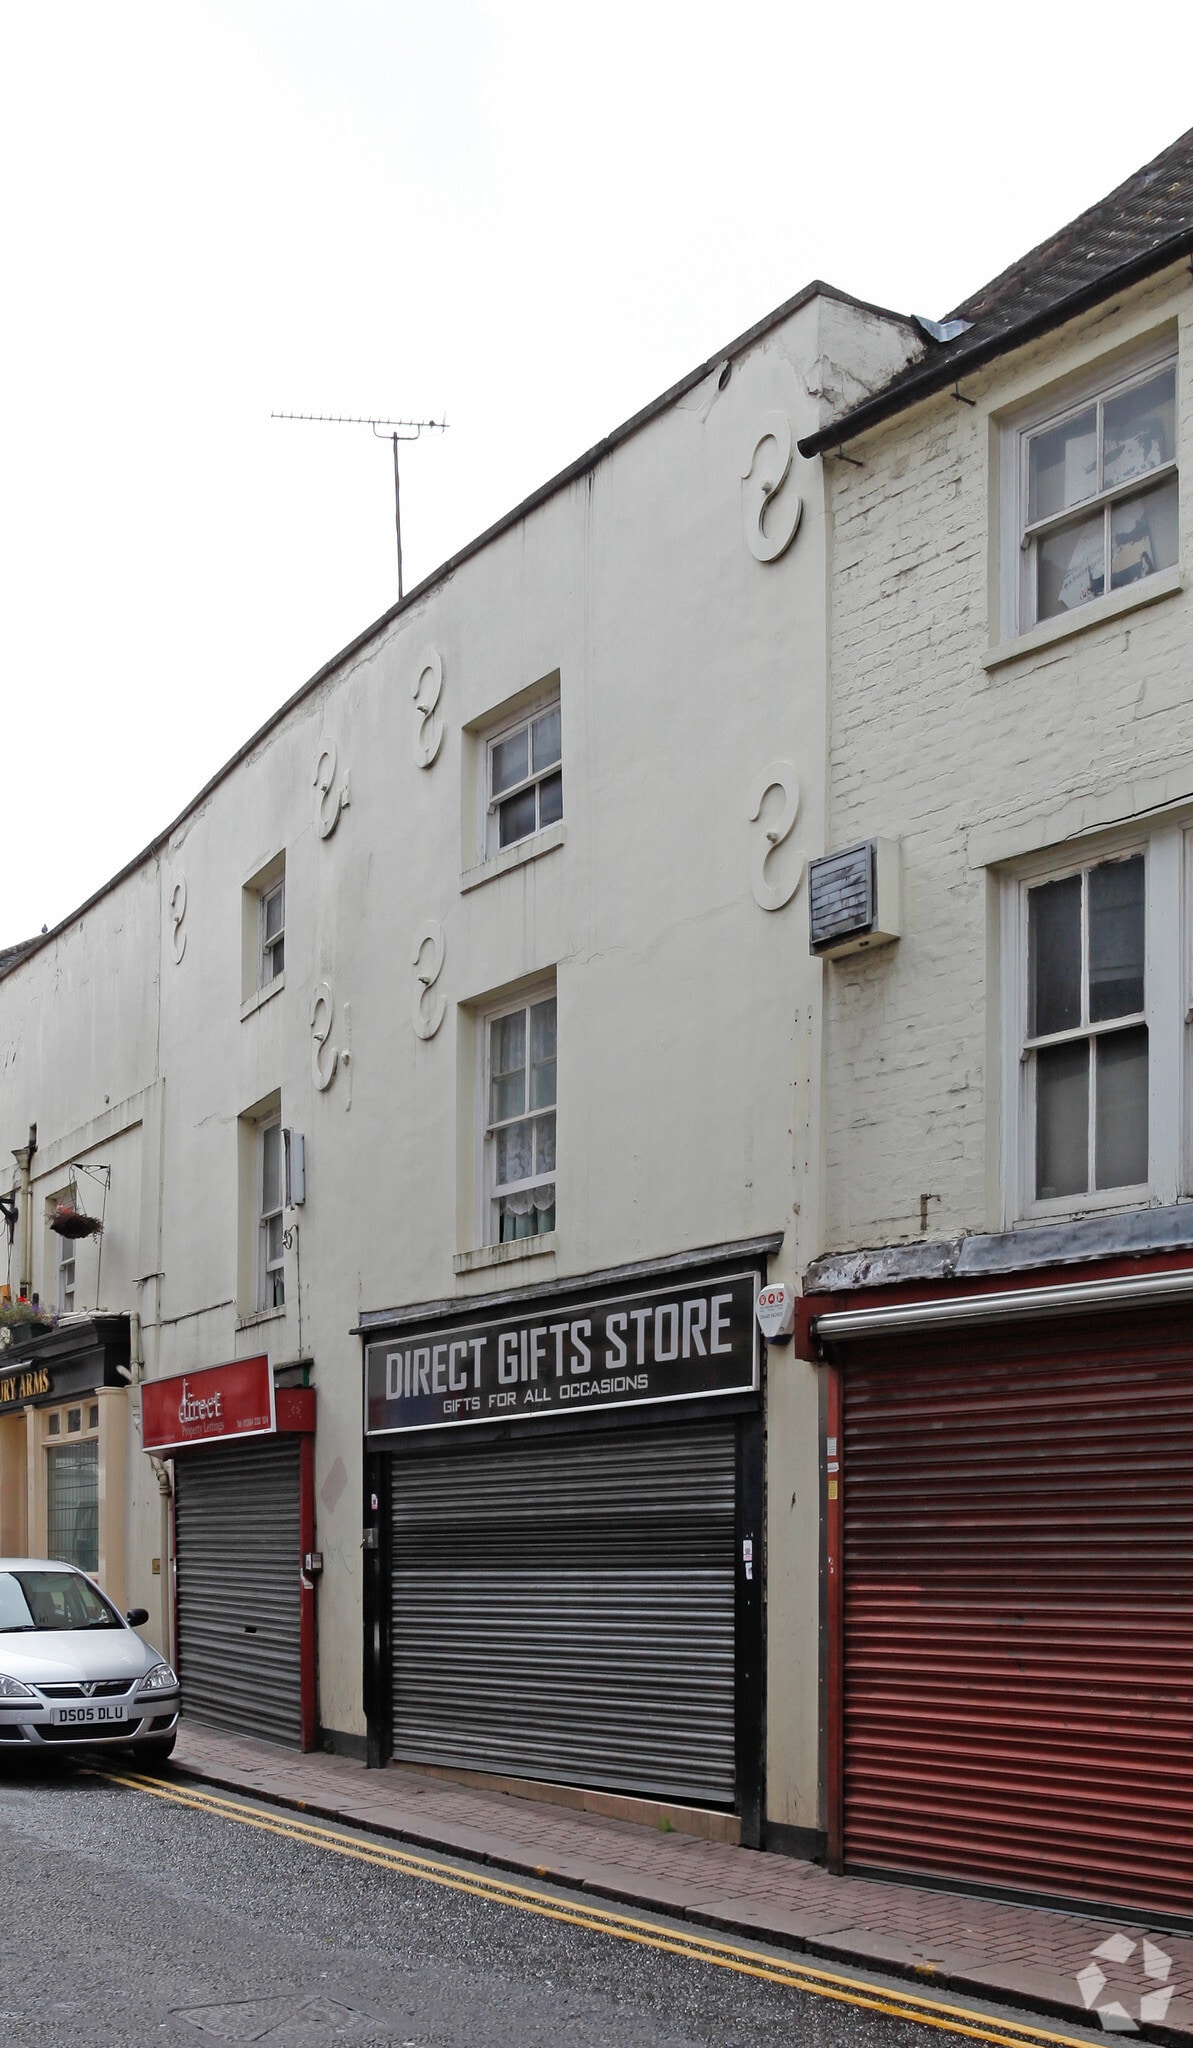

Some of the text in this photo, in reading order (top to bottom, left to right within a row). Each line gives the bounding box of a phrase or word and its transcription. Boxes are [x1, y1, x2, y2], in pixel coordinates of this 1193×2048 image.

[385, 1293, 733, 1401] DIRECT GIFTS STORE
[19, 1367, 49, 1398] ARMS
[178, 1378, 222, 1423] direct
[443, 1373, 649, 1414] GIFTS FOR ALL OCCASIONS
[203, 1420, 225, 1434] Lettings
[59, 1706, 123, 1722] DS05 DLU
